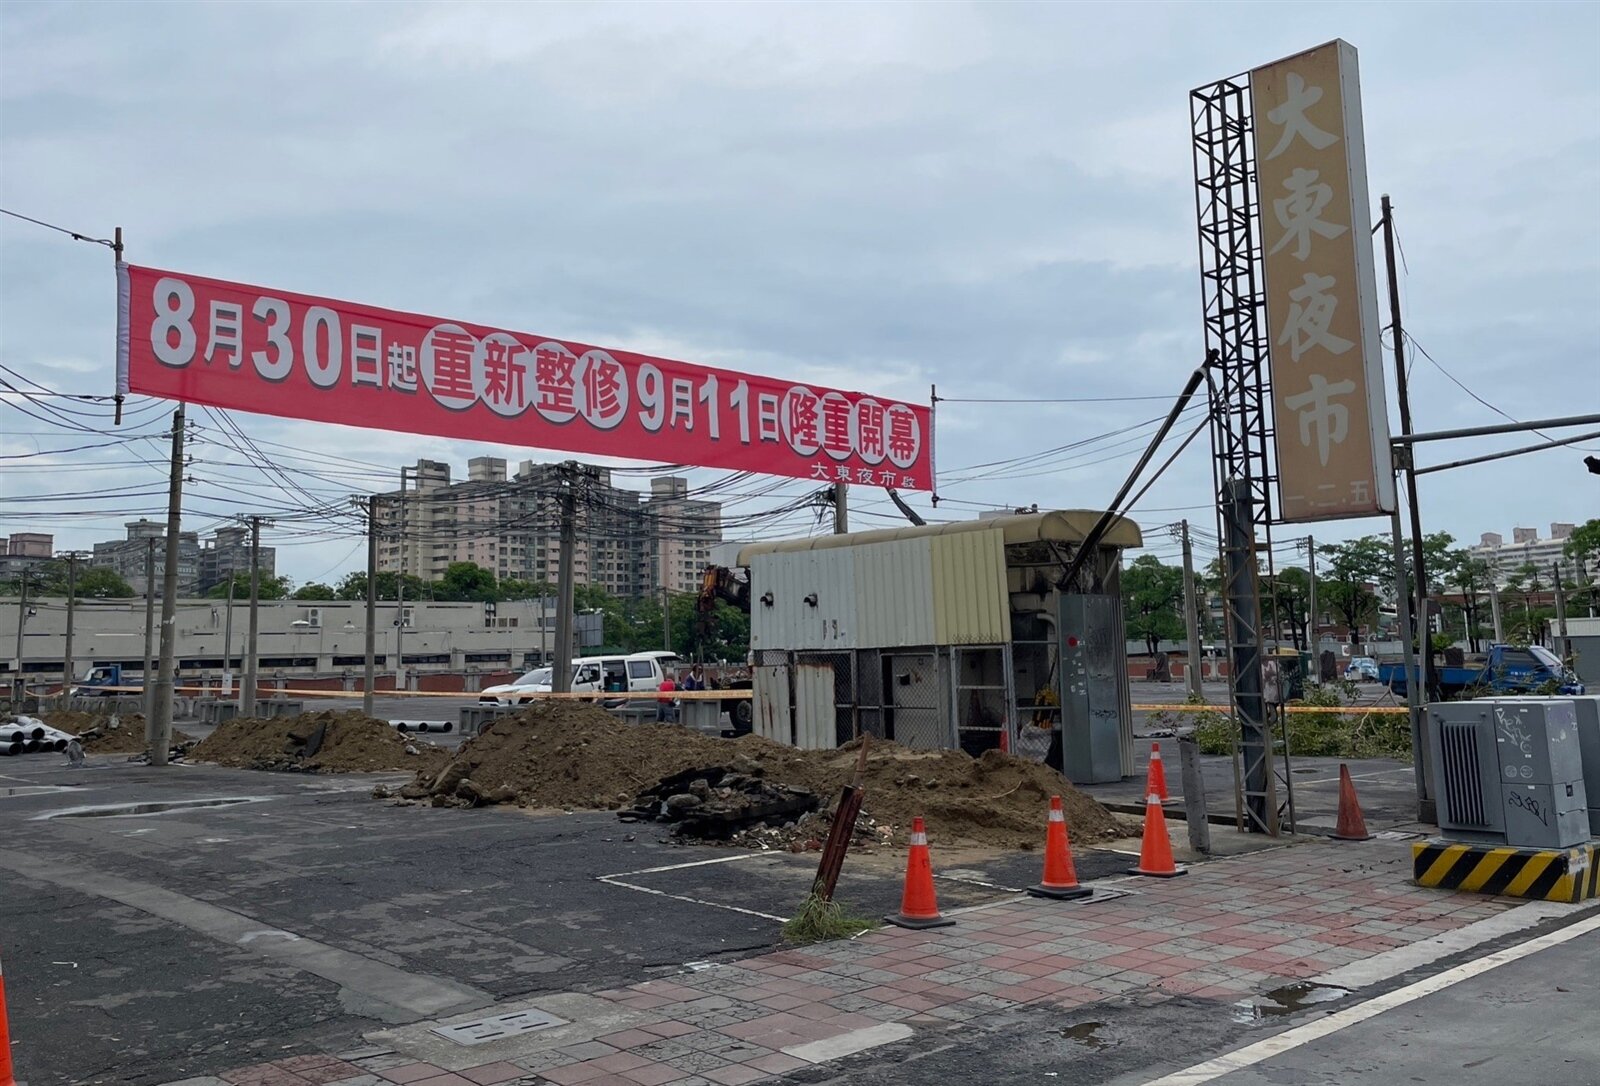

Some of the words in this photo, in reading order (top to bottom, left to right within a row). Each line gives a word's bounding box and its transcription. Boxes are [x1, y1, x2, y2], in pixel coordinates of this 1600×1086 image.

[151, 277, 916, 461] 8月30日起重新整修9月11日隆重開幕
[1264, 72, 1356, 467] 大東夜市
